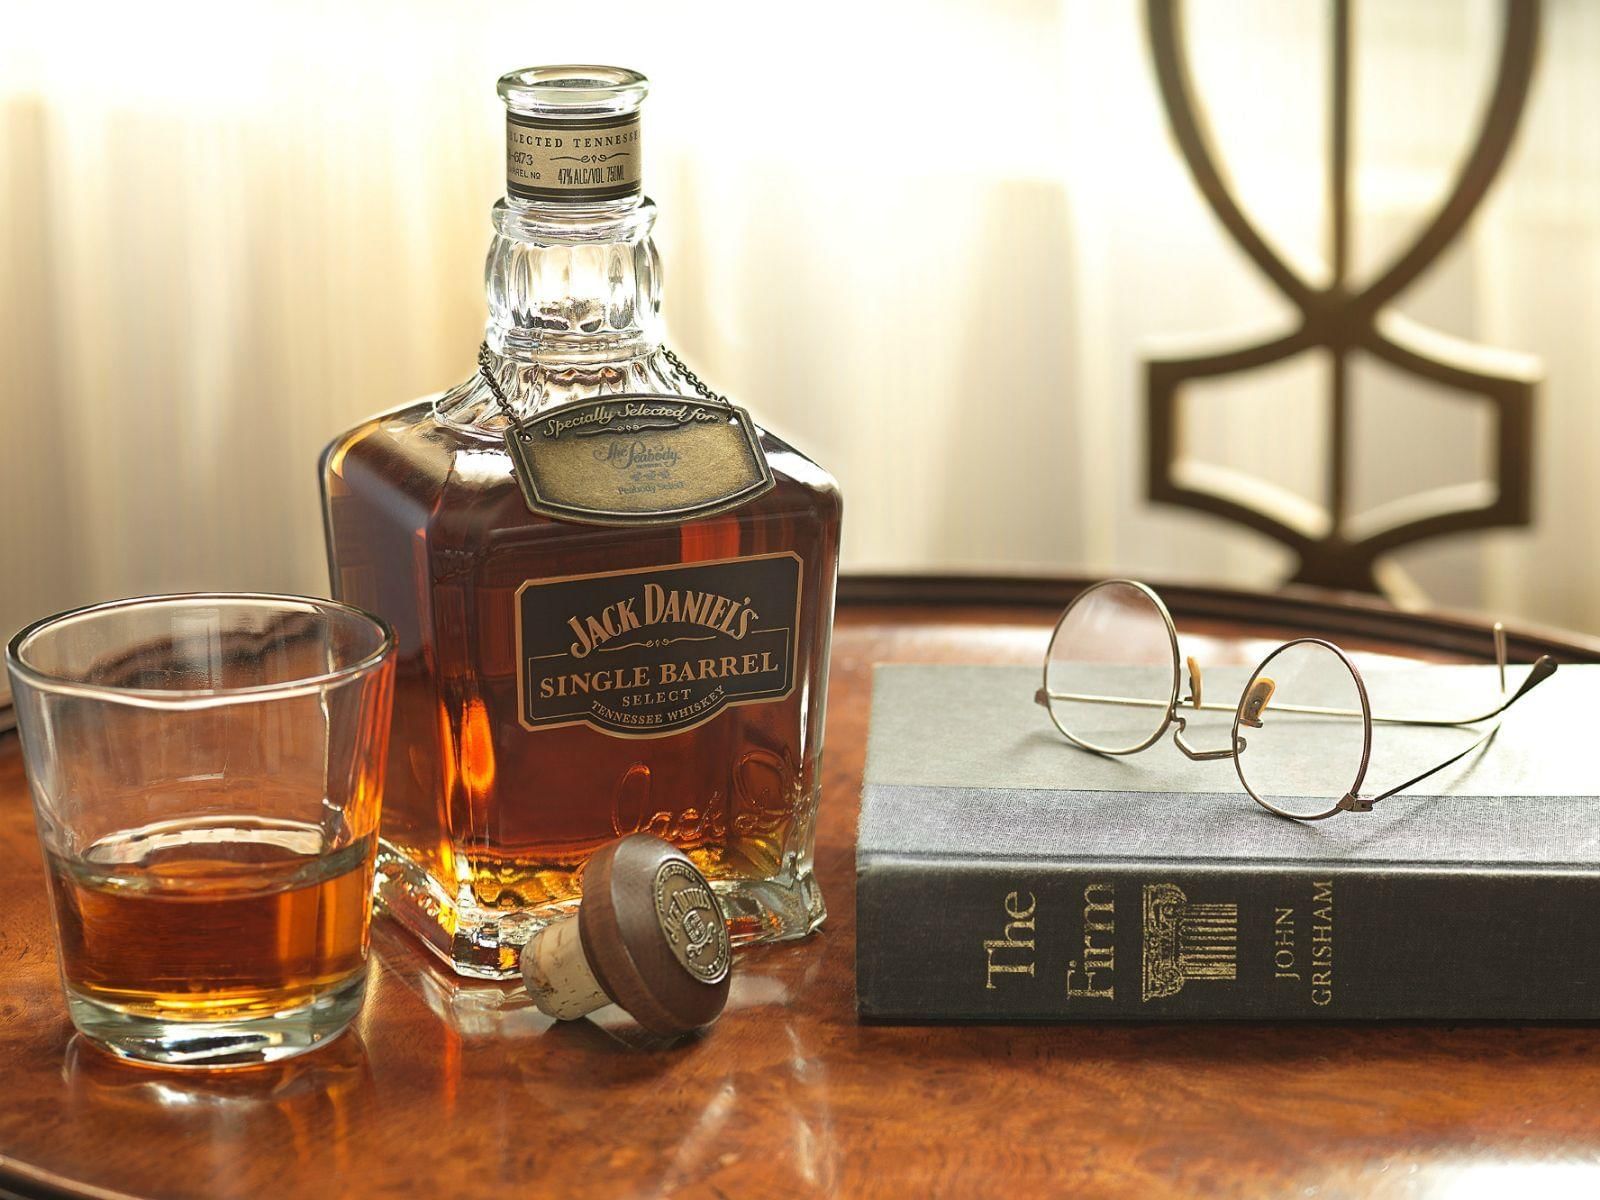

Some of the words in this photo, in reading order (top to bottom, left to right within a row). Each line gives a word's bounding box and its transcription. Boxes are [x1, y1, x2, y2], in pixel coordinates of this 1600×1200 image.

[543, 405, 613, 439] Specially
[617, 402, 688, 420] Selected
[687, 408, 719, 424] for
[612, 440, 680, 469] Peabody
[567, 597, 640, 659] JACK
[643, 583, 759, 640] DANIEL'S
[540, 666, 650, 699] SINGLE
[659, 652, 779, 685] BARREL
[592, 700, 663, 725] TENNESSEE
[667, 685, 726, 722] WHISKEY
[622, 688, 692, 707] SELECT
[983, 890, 1037, 990] The
[1066, 881, 1115, 1001] Firm
[1274, 906, 1301, 981] JOHN
[1310, 880, 1334, 1007] GRISHAM
